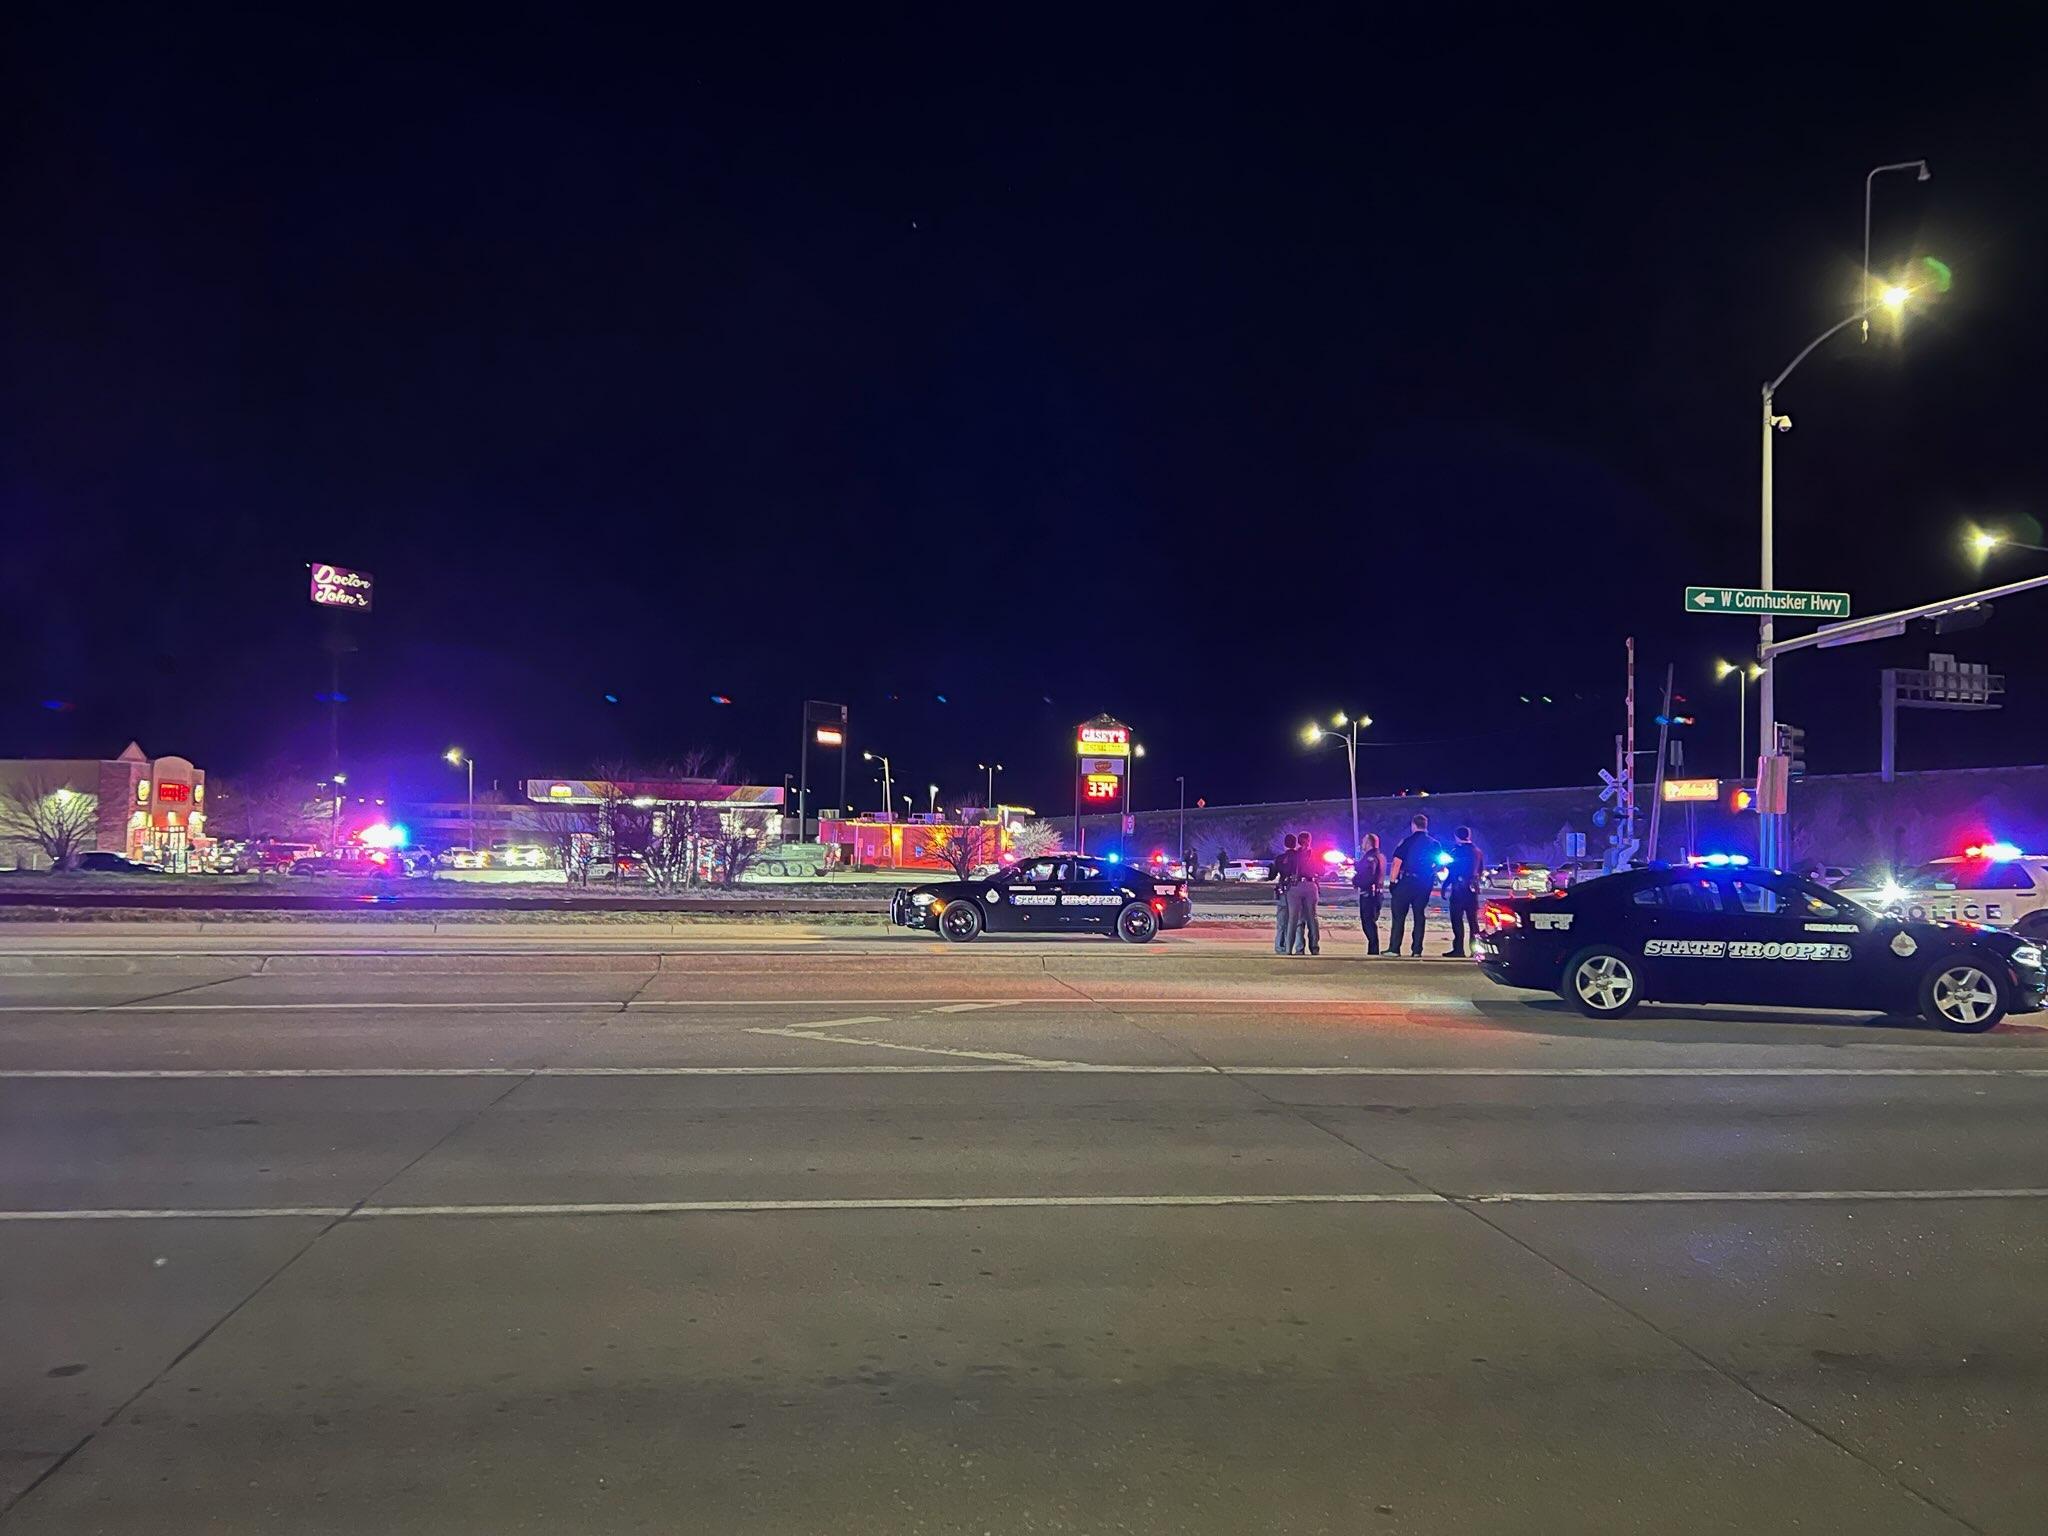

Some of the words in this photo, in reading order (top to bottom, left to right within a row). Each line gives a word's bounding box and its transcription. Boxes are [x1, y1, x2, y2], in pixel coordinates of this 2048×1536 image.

[313, 565, 370, 589] Doctor
[314, 583, 369, 606] John's
[1720, 591, 1733, 608] W
[1735, 591, 1808, 610] Cornhusker
[1810, 594, 1842, 615] Hwy
[1081, 728, 1126, 743] CASEY'S
[1014, 895, 1057, 906] STATE
[1061, 895, 1123, 906] TROOPER
[1644, 940, 1727, 958] STATE
[1728, 942, 1852, 961] TROOPER
